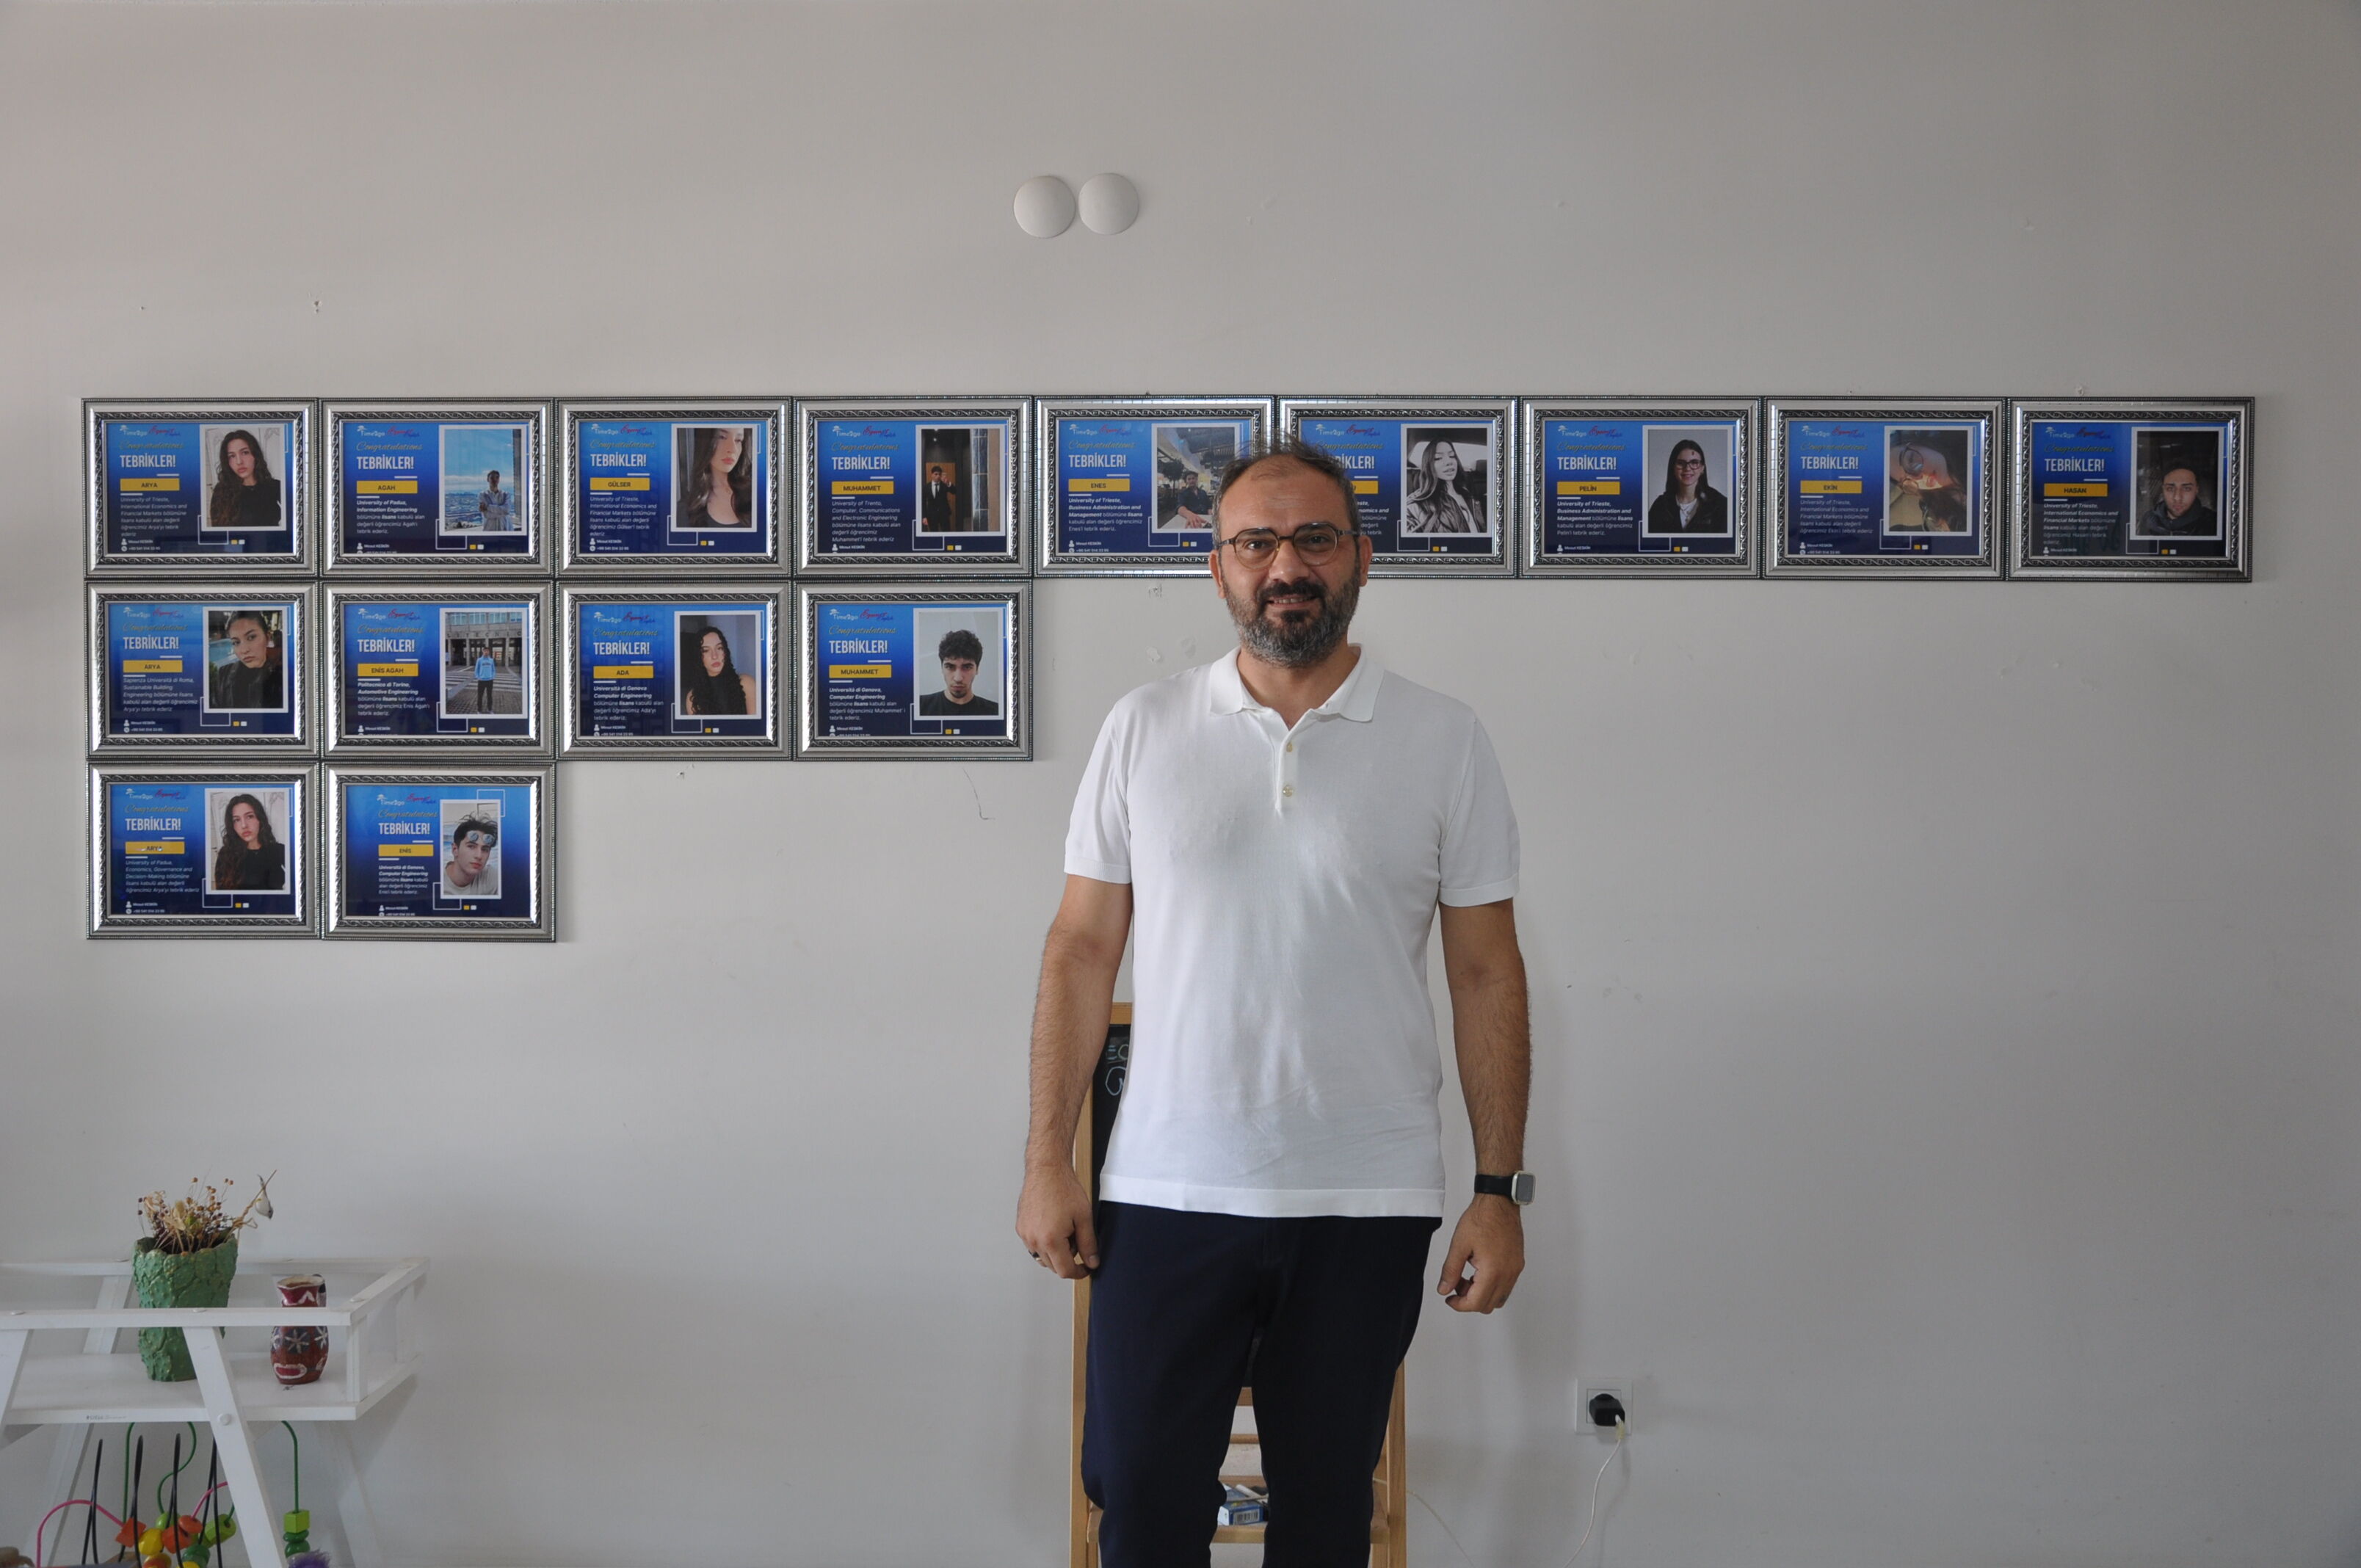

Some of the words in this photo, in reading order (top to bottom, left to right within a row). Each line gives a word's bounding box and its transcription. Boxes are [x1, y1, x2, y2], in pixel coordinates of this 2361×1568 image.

[120, 453, 176, 467] TEBRİKLER!
[357, 454, 413, 469] TEBRİKLER!
[590, 452, 647, 467] TEBRİKLER!
[832, 455, 890, 470] TEBRİKLER!
[1069, 452, 1125, 467] TEBRİKLER!
[1557, 455, 1617, 470] TEBRİKLER!
[1801, 454, 1858, 469] TEBRİKLER!
[2045, 457, 2105, 471] TEBRİKLER!
[123, 635, 178, 649] TEBRİKLER!
[358, 637, 415, 652] TEBRİKLER!
[594, 640, 650, 655] TEBRİKLER!
[829, 639, 888, 653] TEBRİKLER!
[126, 816, 181, 831] TEBRİKLER!
[379, 821, 430, 834] TEBRİKLER!
